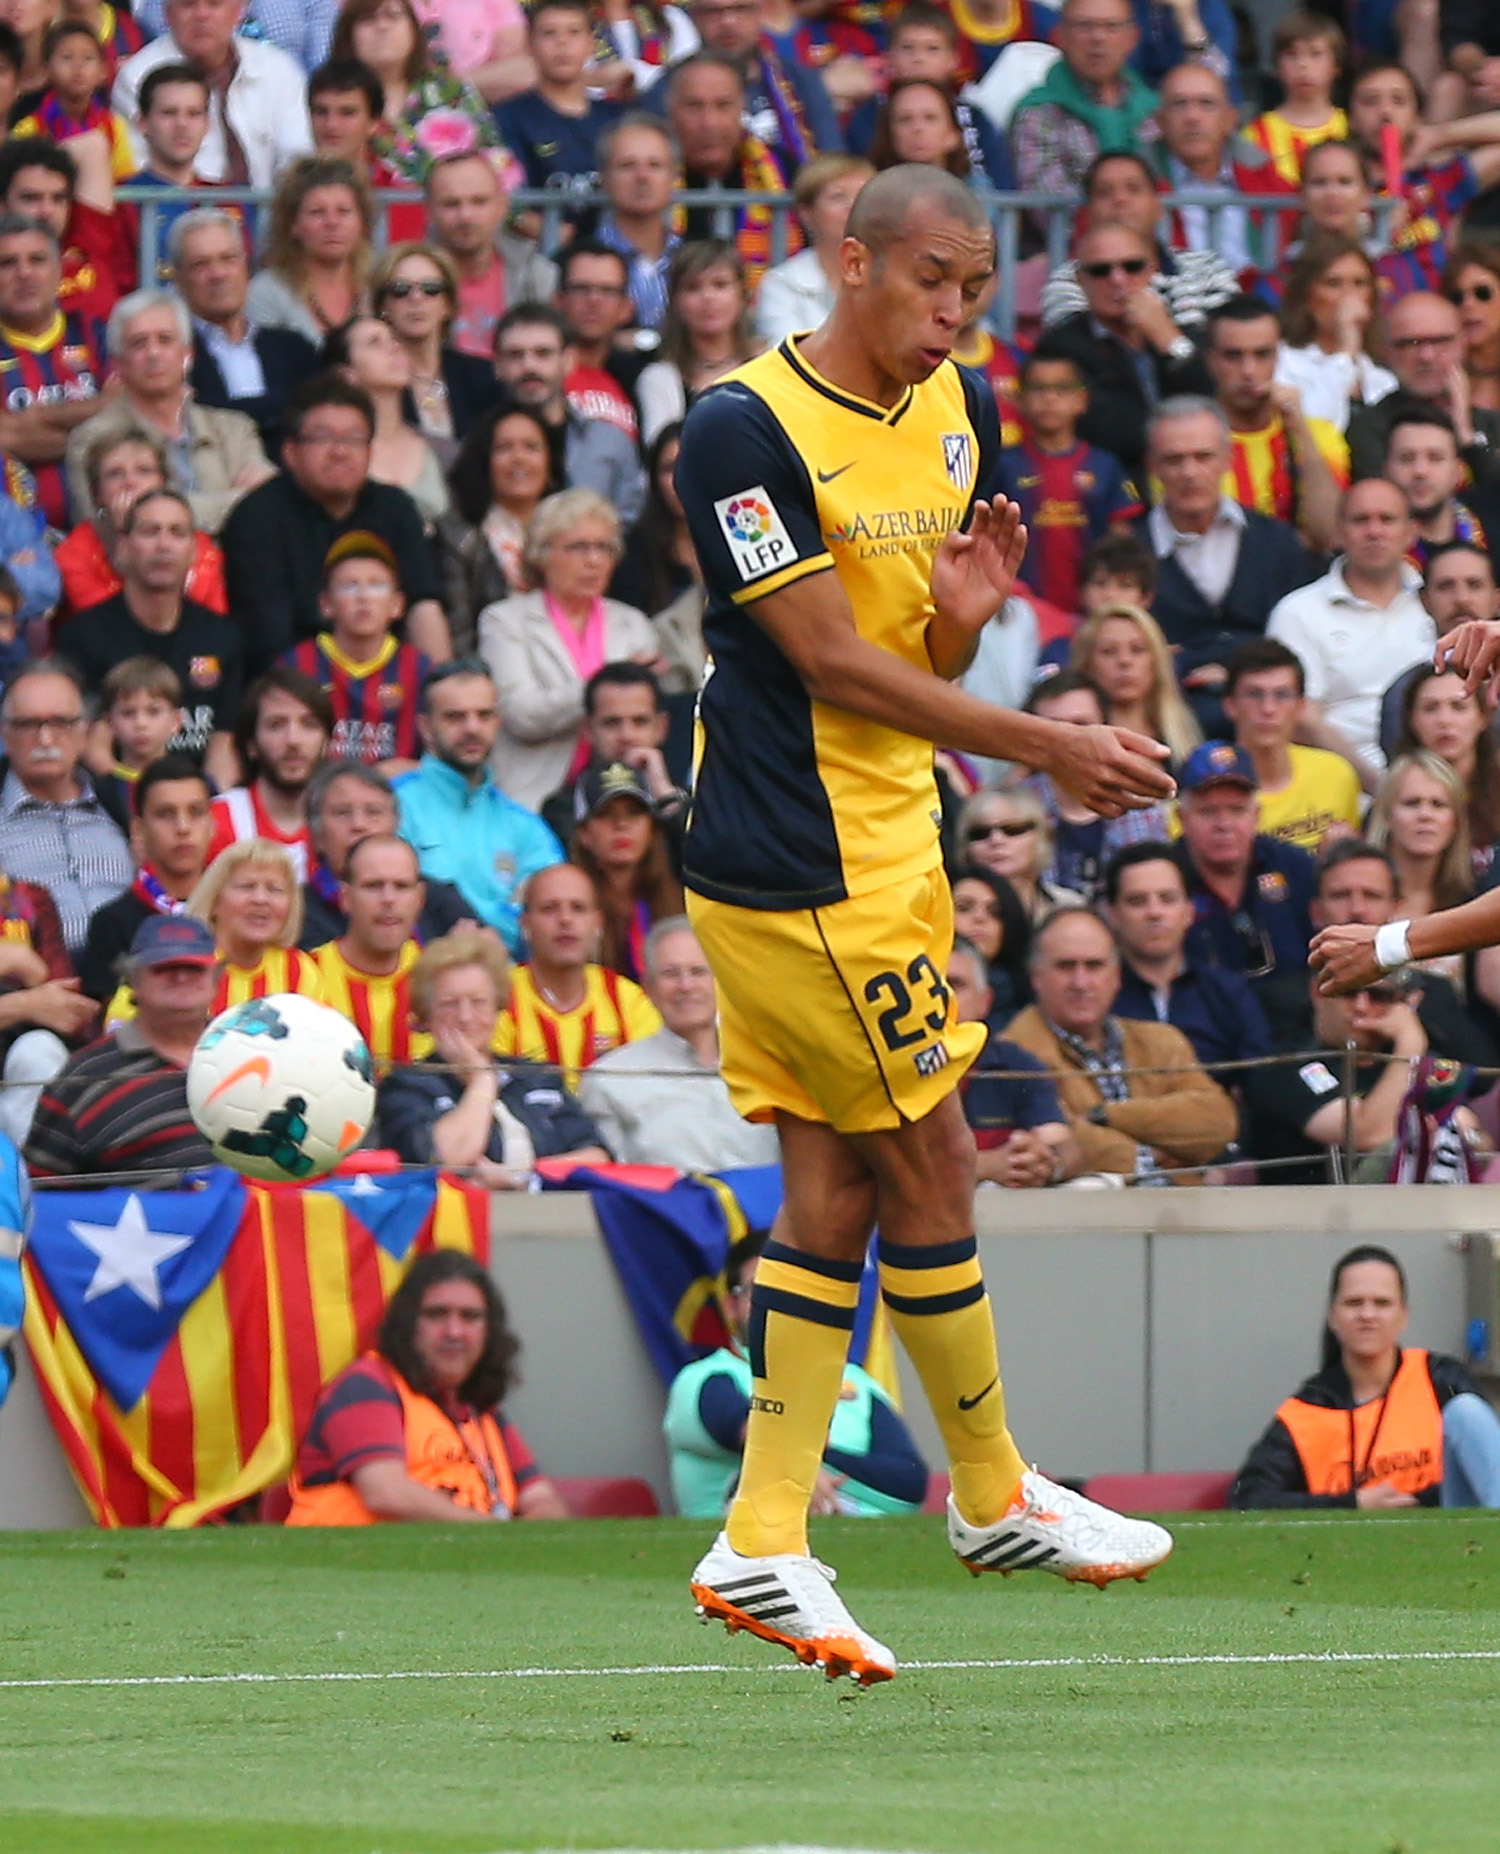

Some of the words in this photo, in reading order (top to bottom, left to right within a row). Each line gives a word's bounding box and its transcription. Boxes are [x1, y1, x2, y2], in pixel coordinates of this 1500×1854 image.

[850, 507, 961, 541] AZERBAIJA
[741, 538, 785, 574] LFP
[860, 542, 899, 559] LAND
[864, 952, 951, 1052] 23
